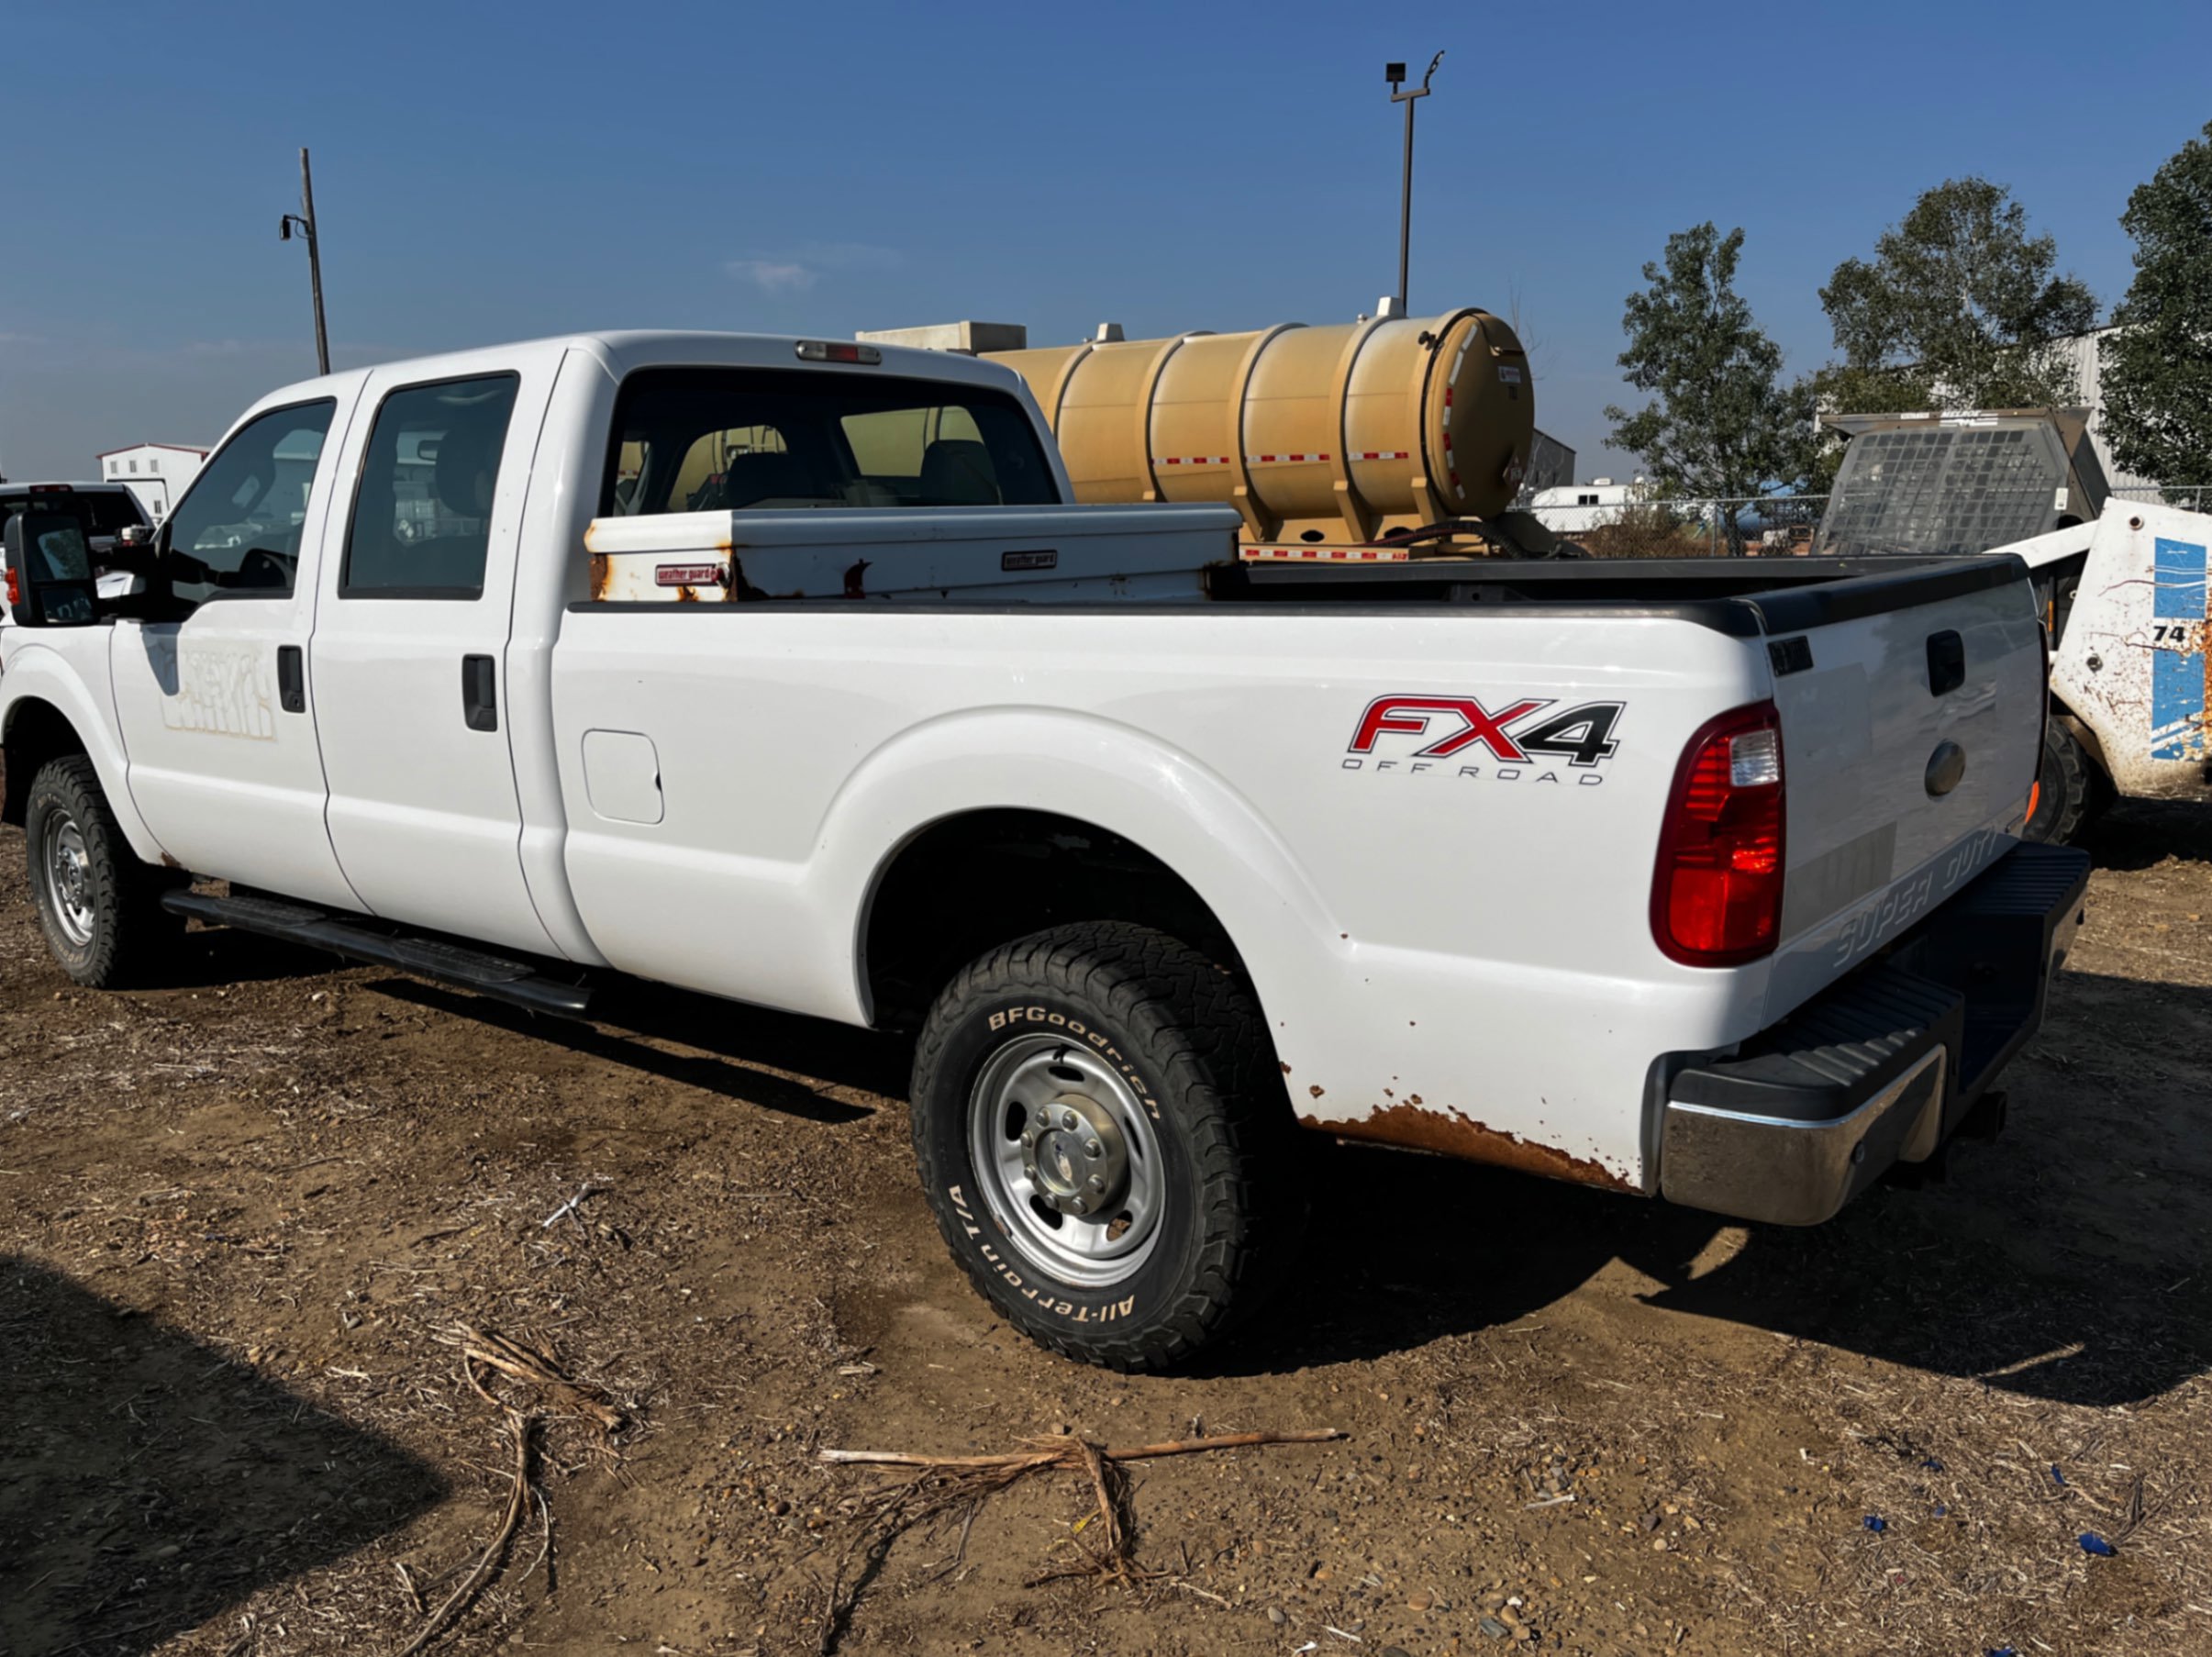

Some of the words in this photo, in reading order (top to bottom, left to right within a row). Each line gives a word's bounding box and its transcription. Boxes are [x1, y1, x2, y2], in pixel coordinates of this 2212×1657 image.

[658, 568, 687, 580] weather
[688, 567, 710, 580] guard
[1347, 694, 1628, 768] FX4
[1833, 871, 1934, 968] SUPER
[1942, 825, 1998, 890] DUTY
[988, 1007, 1160, 1119] BFGoodrich
[949, 1184, 979, 1241] T/A
[980, 1244, 1137, 1323] All-Terrain
